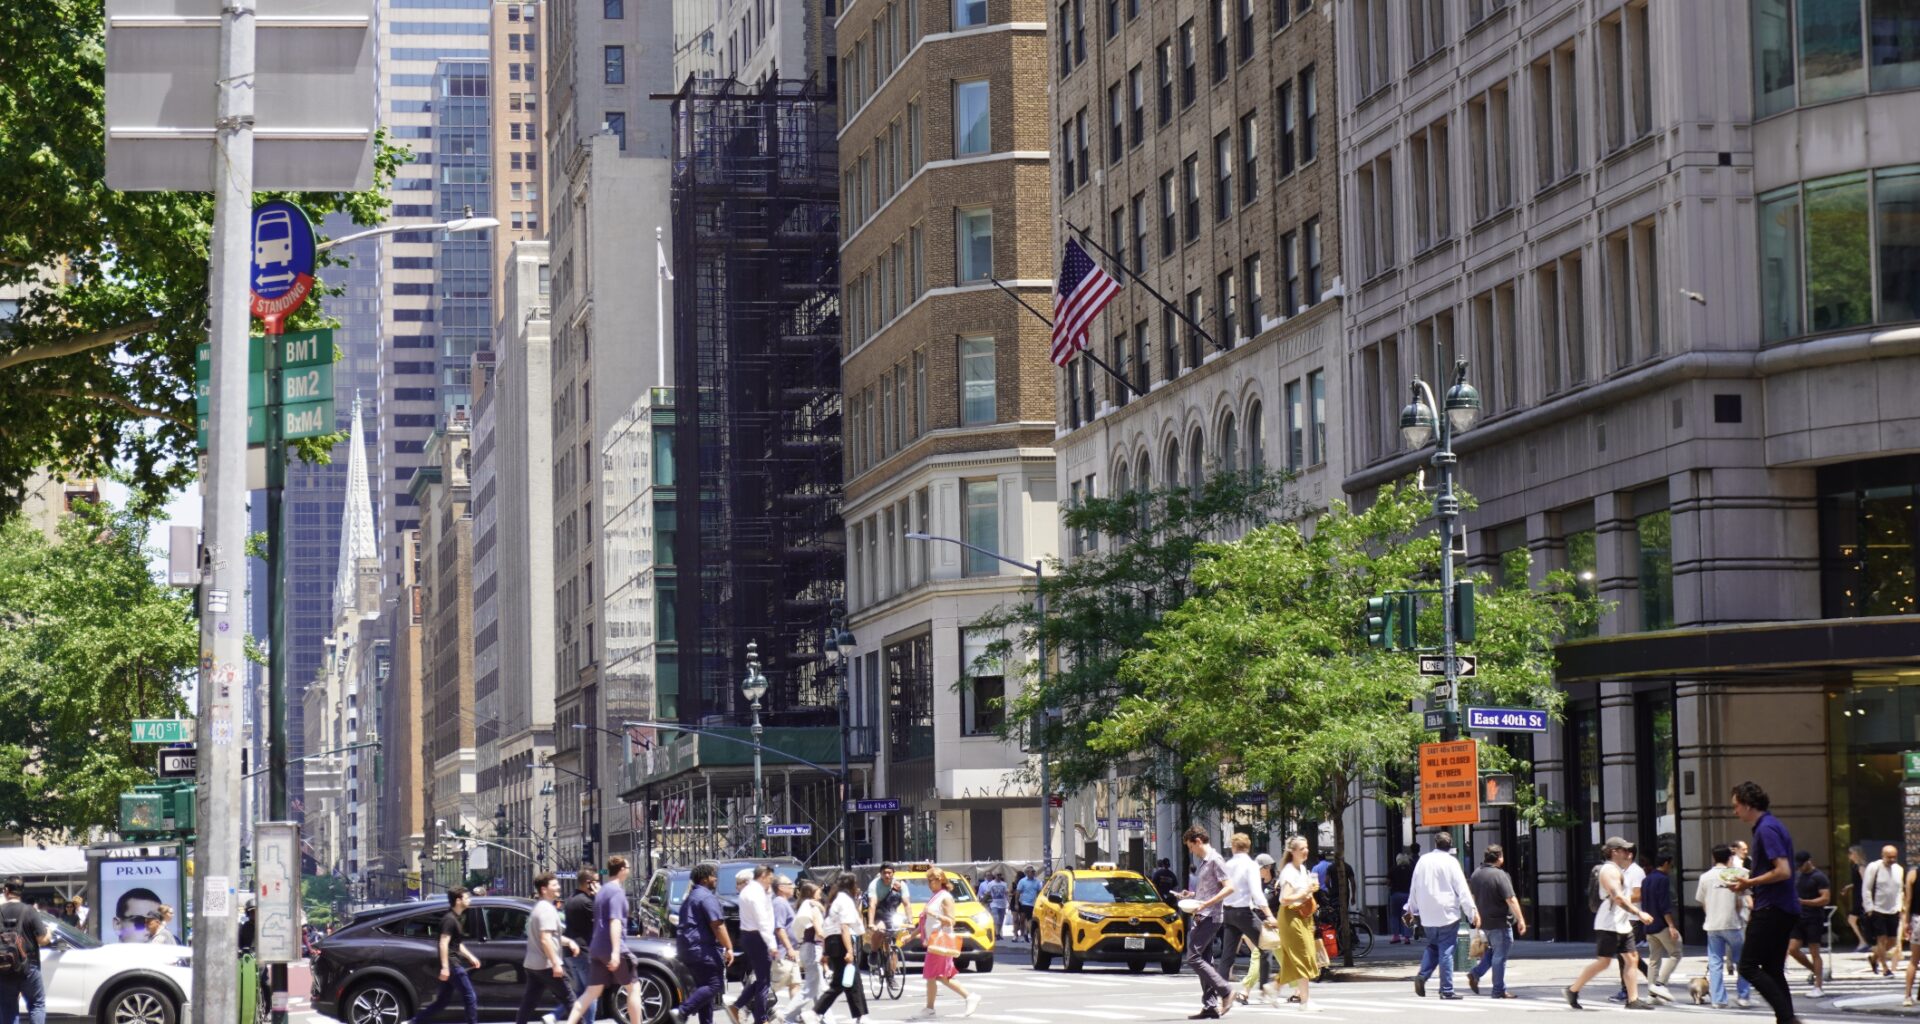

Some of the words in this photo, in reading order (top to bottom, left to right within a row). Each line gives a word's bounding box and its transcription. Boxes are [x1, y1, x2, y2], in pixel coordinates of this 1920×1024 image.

[257, 282, 305, 313] STANDING
[286, 335, 317, 363] BM1
[287, 371, 320, 398] BM2
[287, 407, 323, 434] BxM4
[1425, 662, 1441, 670] ONE
[1474, 713, 1499, 725] East
[1501, 714, 1526, 726] 40th
[1528, 715, 1542, 727] St
[135, 723, 146, 740] W
[148, 723, 165, 739] 40
[166, 723, 178, 732] ST
[172, 758, 197, 769] ONE
[1435, 768, 1462, 778] BETWEEN
[774, 827, 795, 836] Library
[796, 827, 809, 836] Way
[116, 866, 162, 876] PRADA
